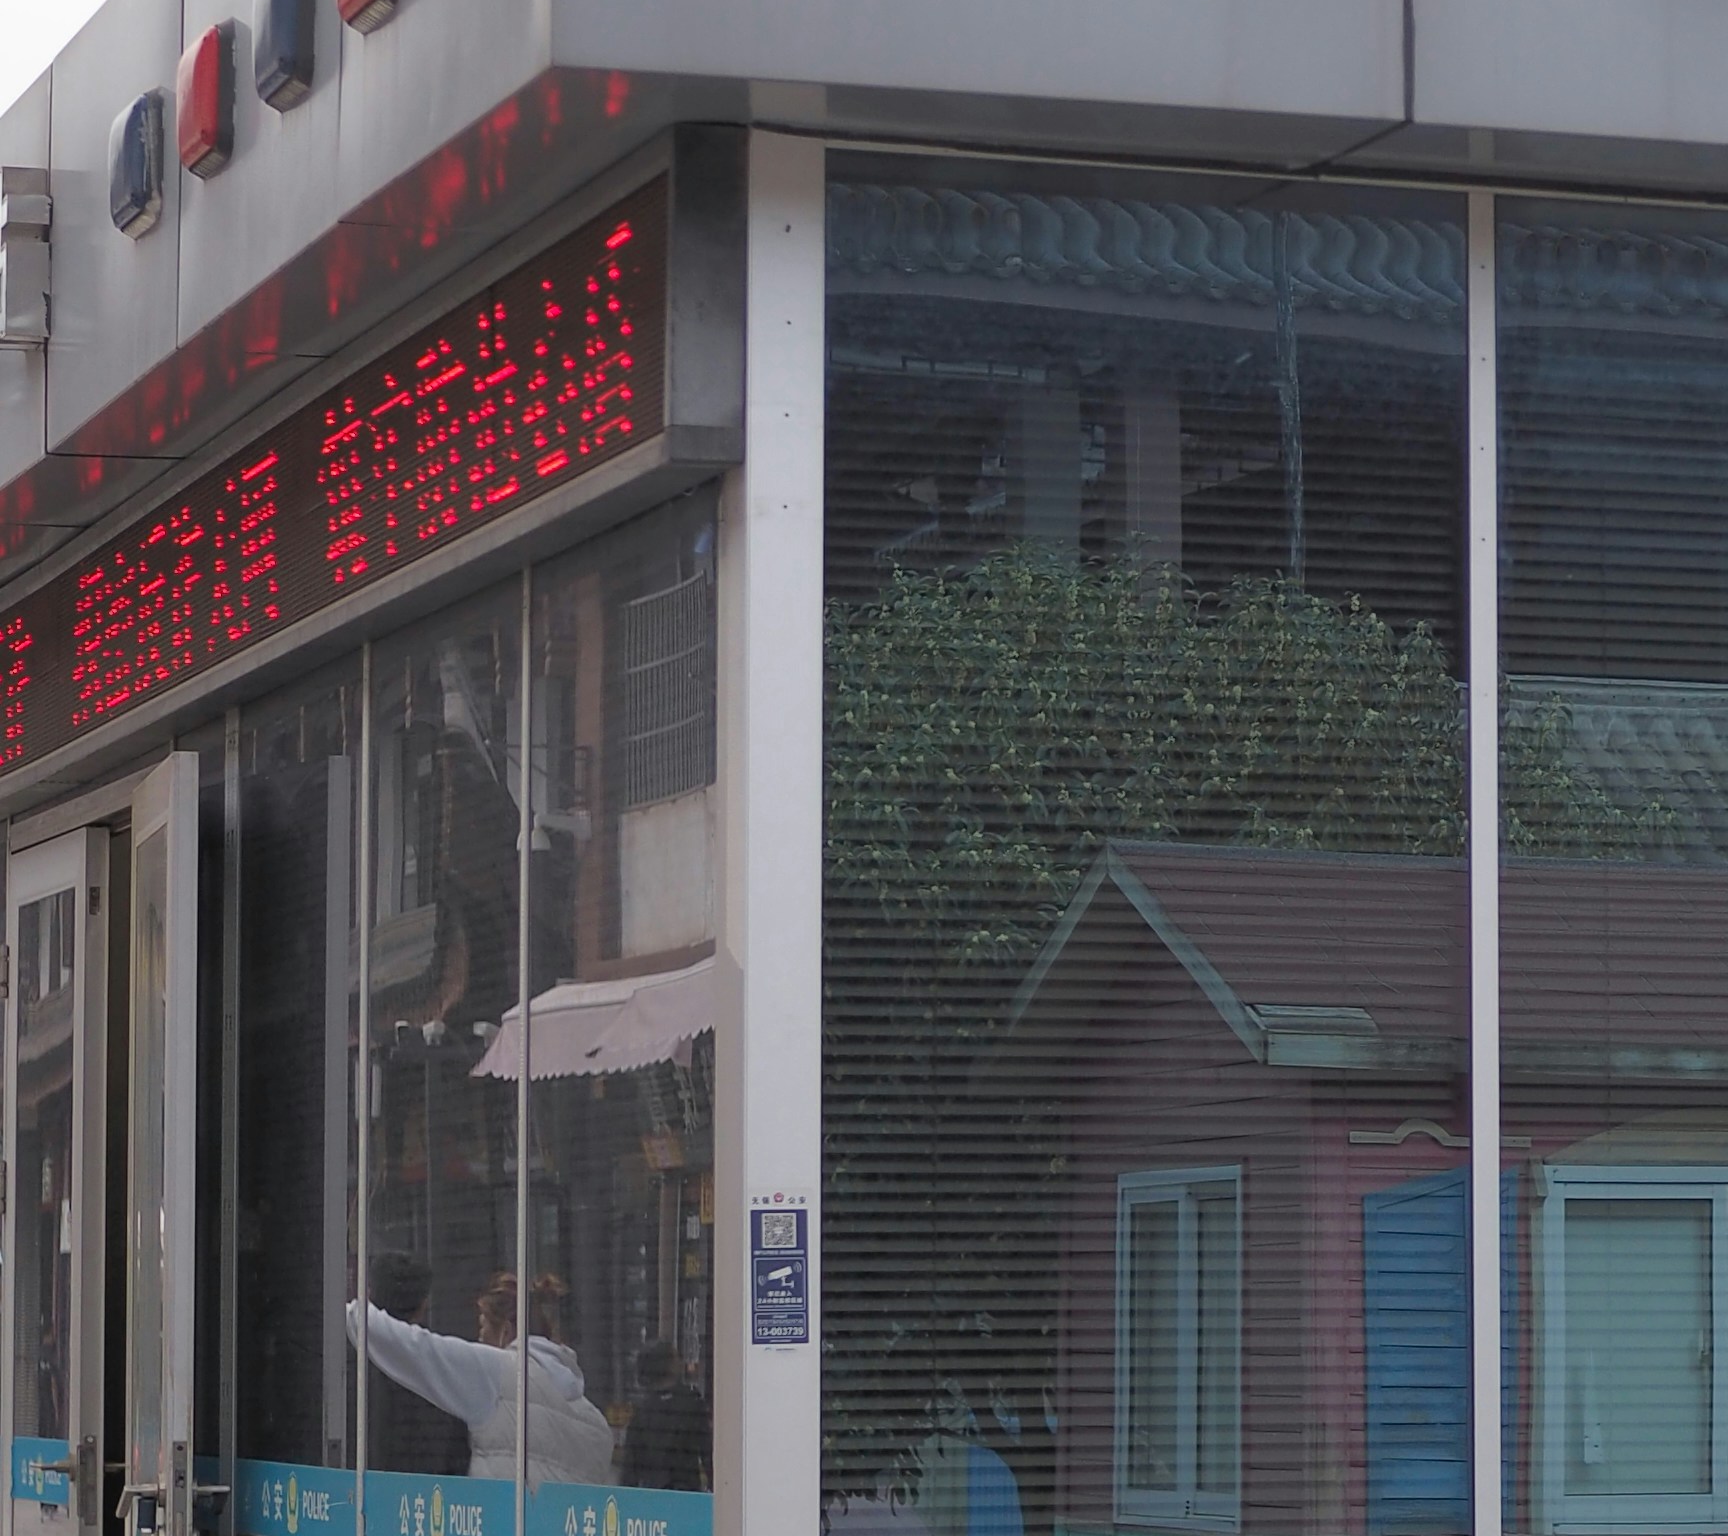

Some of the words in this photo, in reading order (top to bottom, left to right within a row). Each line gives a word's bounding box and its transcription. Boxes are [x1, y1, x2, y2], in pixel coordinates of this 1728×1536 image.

[262, 1479, 283, 1521] 公安
[302, 1490, 330, 1521] POLICE
[450, 1504, 482, 1536] POLICE
